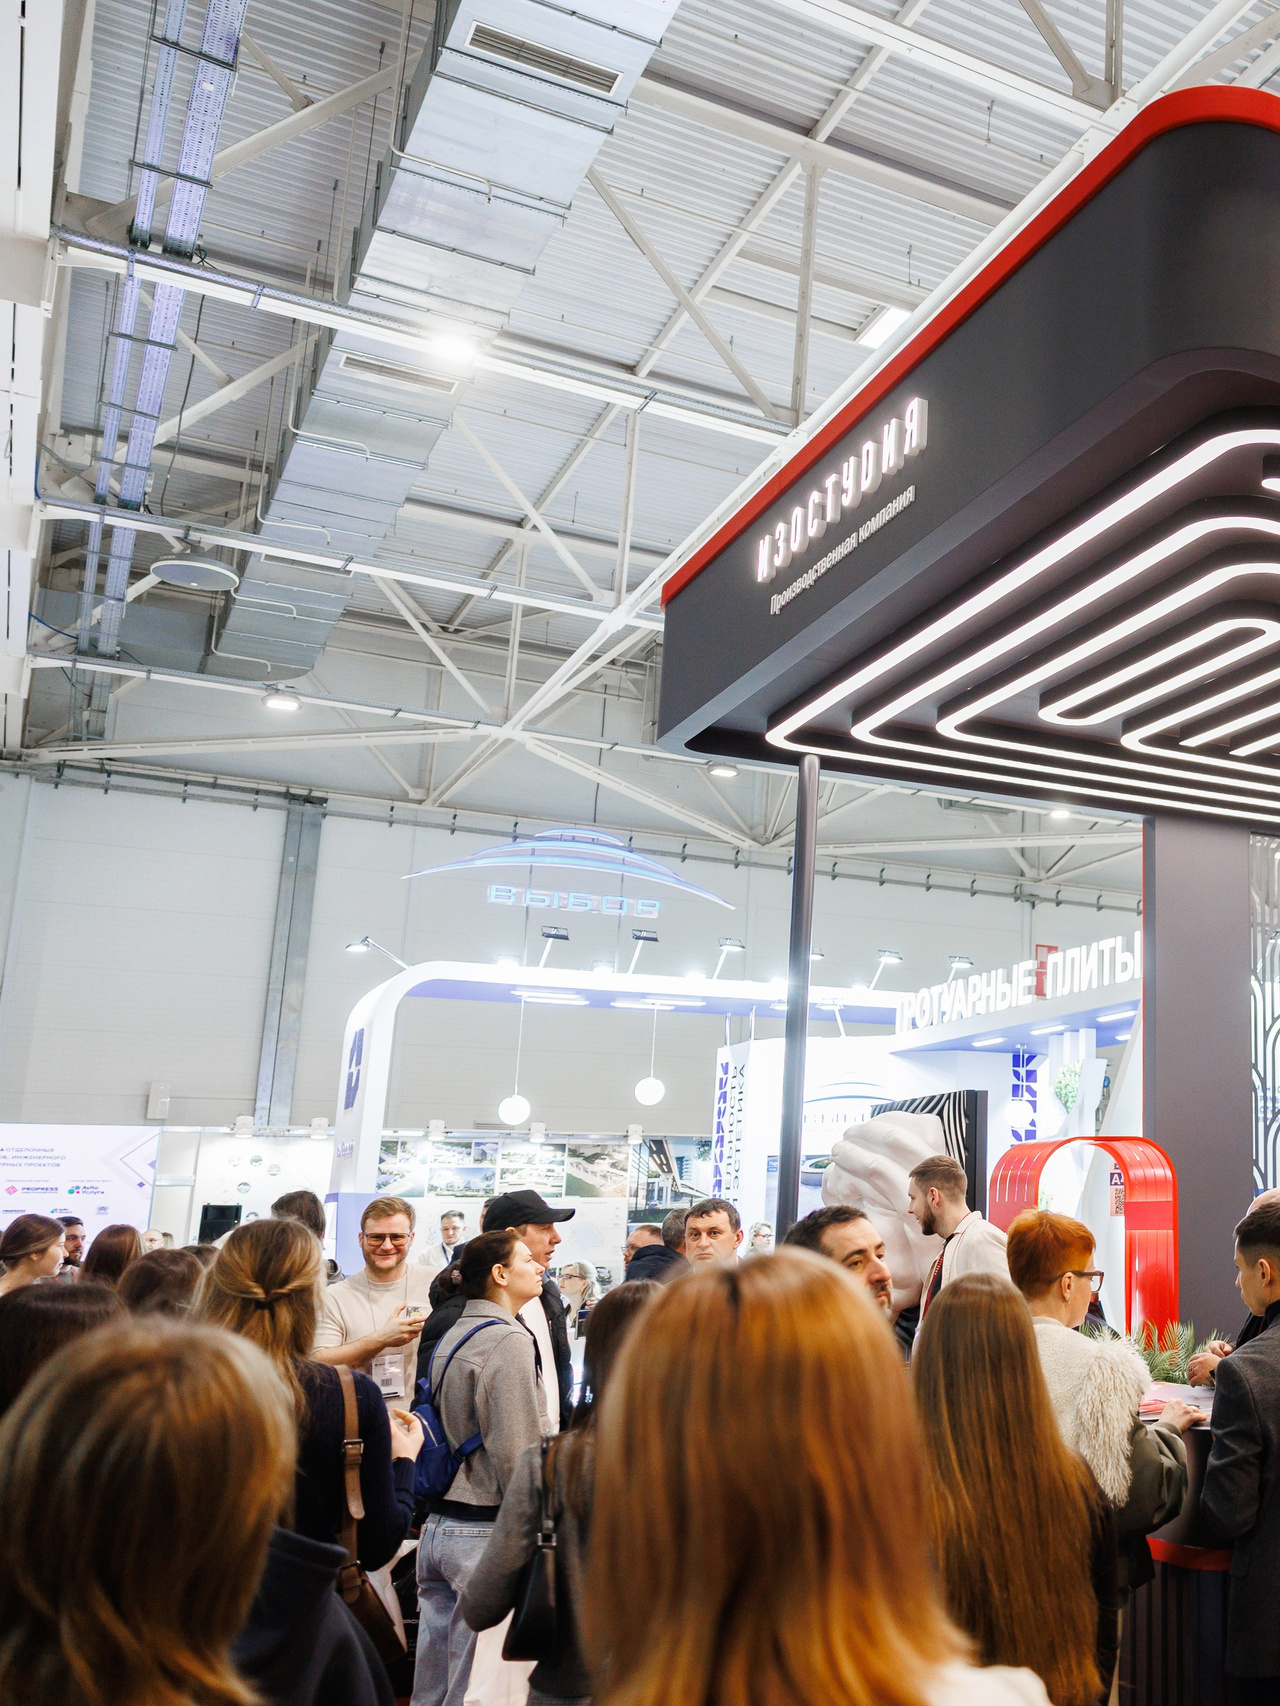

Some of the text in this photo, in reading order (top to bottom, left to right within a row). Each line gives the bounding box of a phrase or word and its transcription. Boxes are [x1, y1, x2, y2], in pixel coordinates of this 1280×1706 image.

[769, 484, 916, 616] Производственная компания
[487, 883, 662, 919] ВЫБОР
[1045, 930, 1142, 1000] ПЛИТЫ
